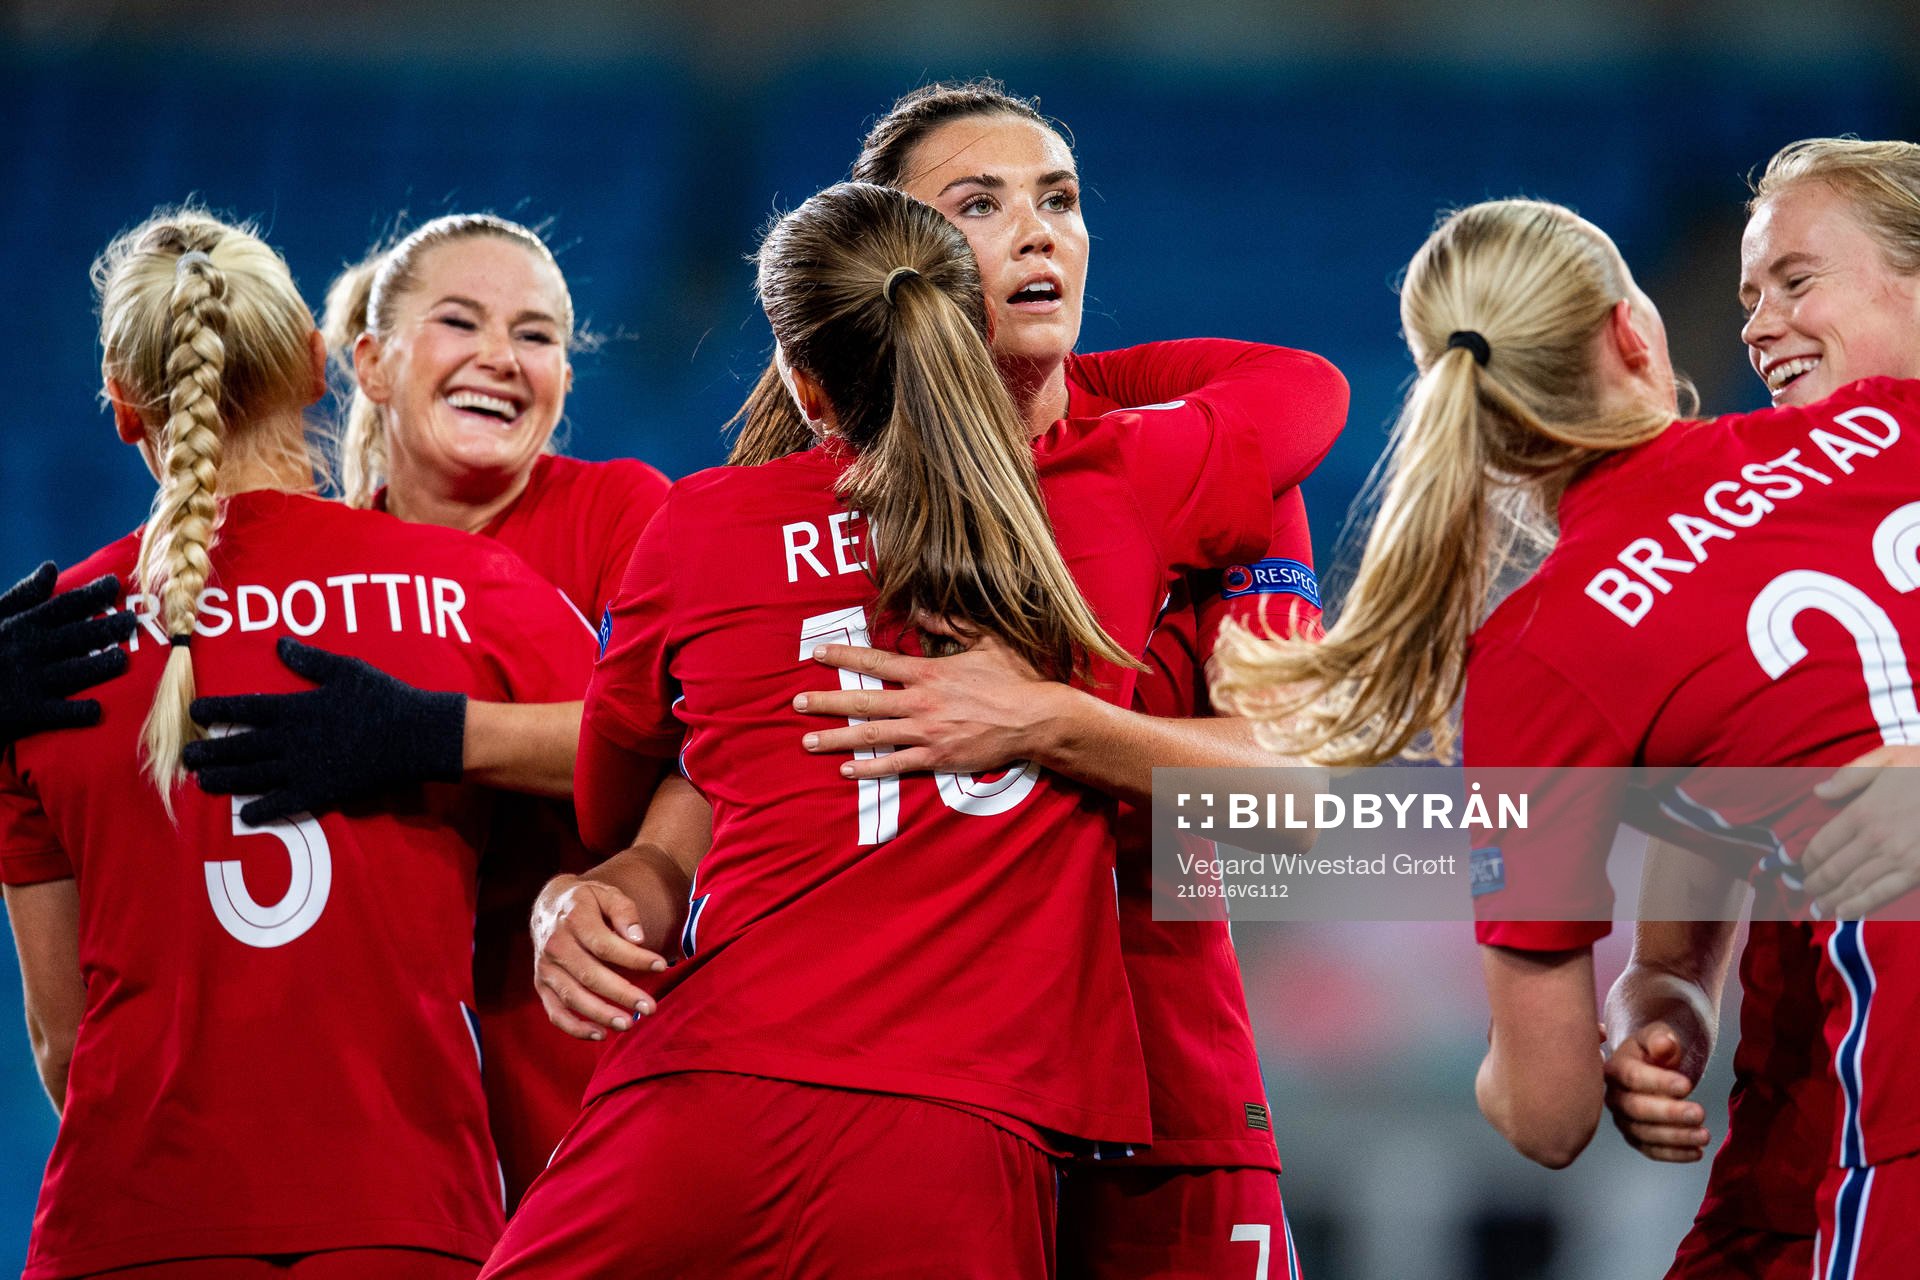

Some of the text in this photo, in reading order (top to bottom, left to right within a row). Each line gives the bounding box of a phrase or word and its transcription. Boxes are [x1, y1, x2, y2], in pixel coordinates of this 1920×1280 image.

[1255, 568, 1318, 598] RESPECT
[1584, 405, 1901, 627] BRAGSTAD
[799, 605, 1041, 845] 1
[1230, 1224, 1271, 1280] 7
